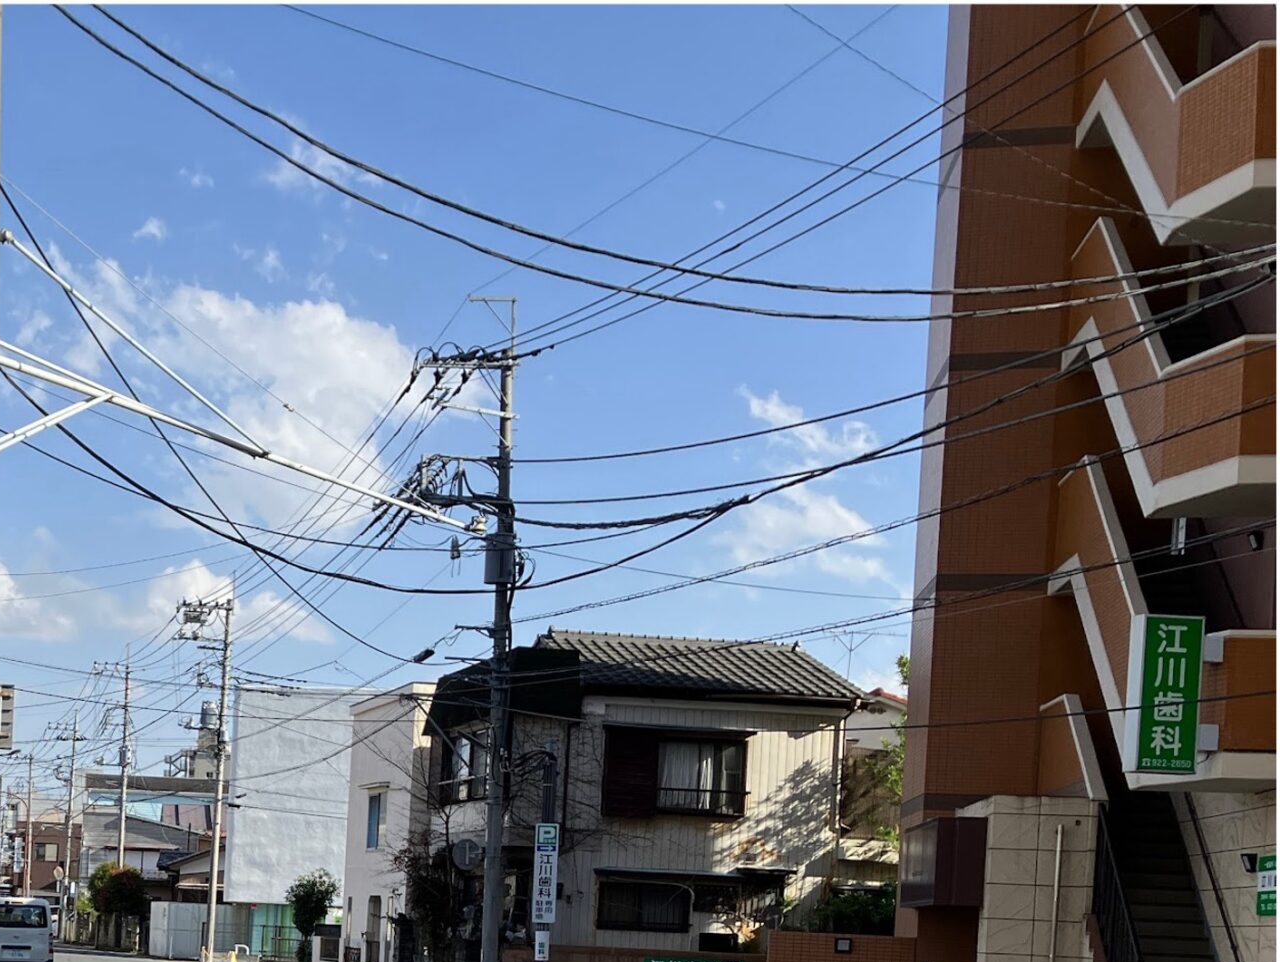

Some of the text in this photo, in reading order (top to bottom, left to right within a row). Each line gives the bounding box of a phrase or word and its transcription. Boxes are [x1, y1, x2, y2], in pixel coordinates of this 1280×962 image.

[1150, 623, 1188, 757] 江川歯科
[538, 853, 553, 898] 江川歯科
